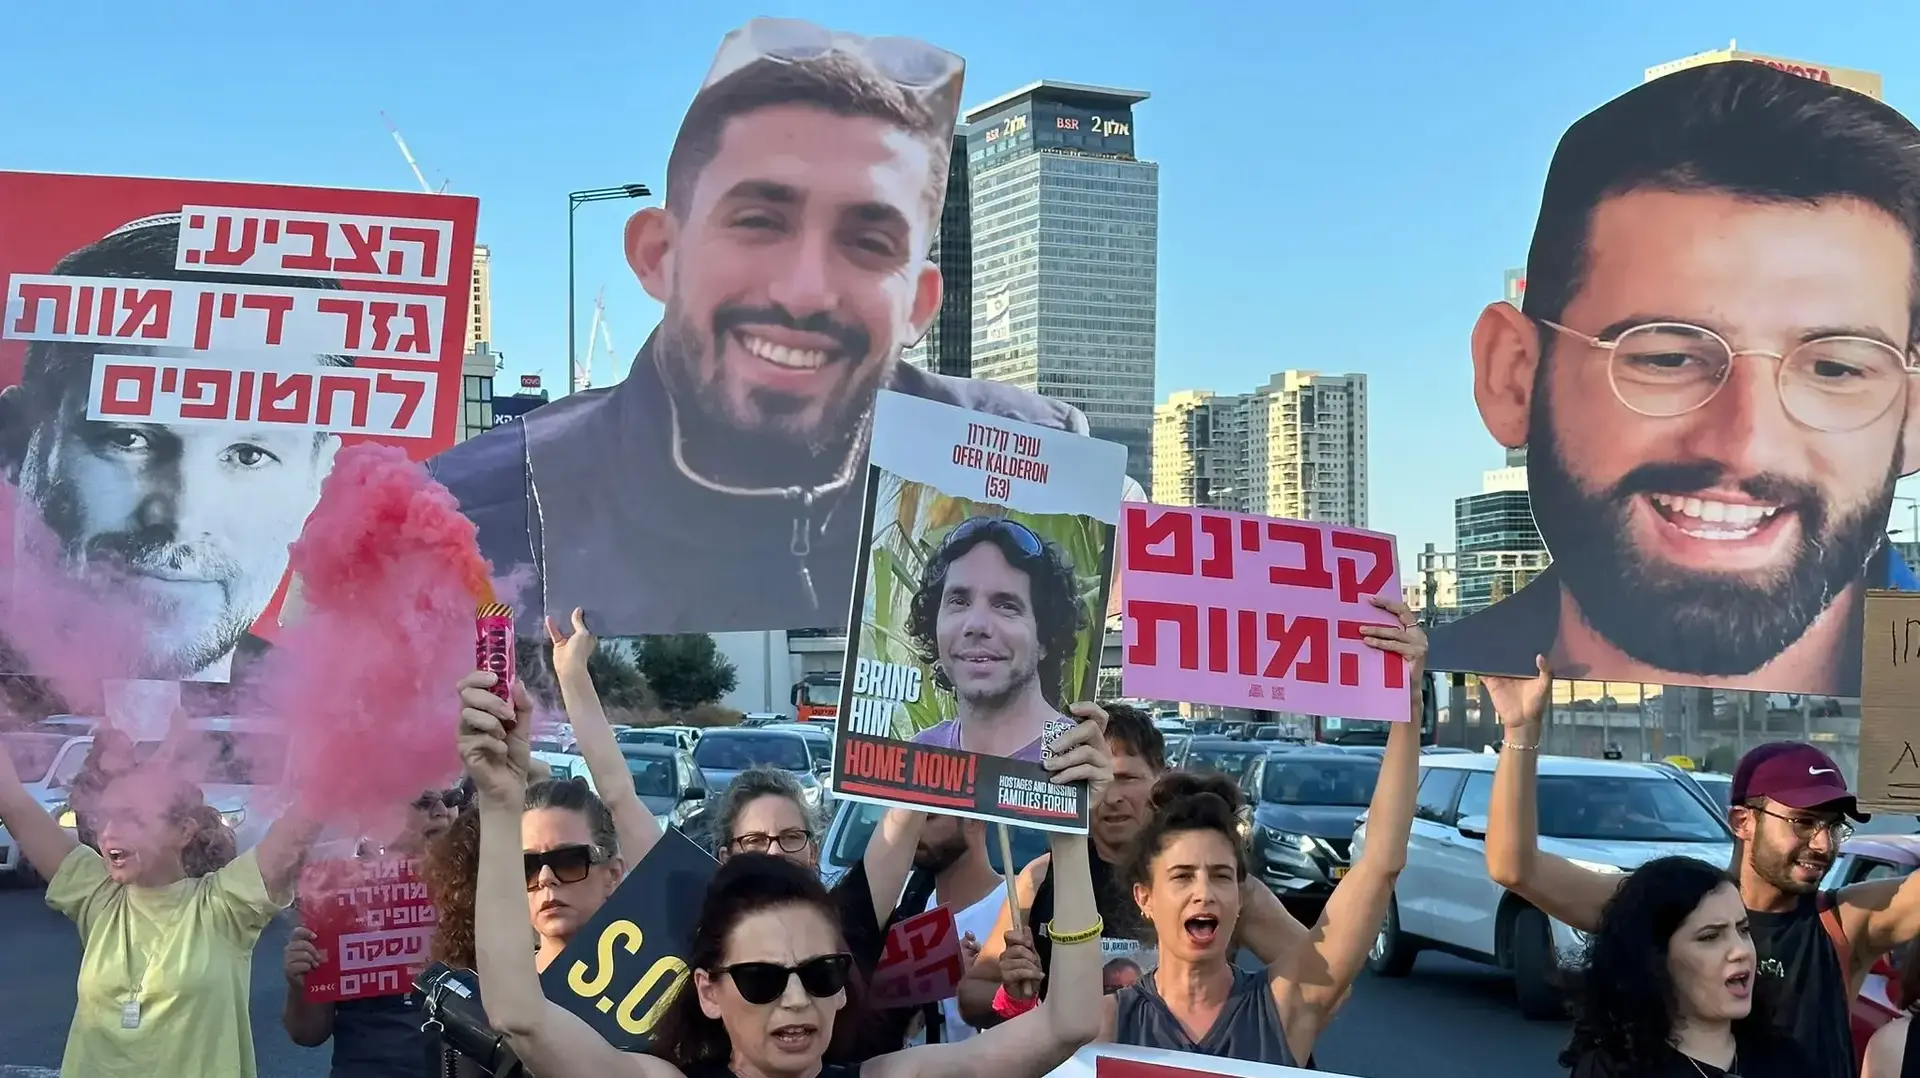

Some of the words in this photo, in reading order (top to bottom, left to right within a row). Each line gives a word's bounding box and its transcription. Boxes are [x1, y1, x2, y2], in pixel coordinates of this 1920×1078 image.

[1003, 117, 1010, 136] 2
[1091, 116, 1102, 132] 2
[1104, 120, 1129, 138] אלון
[185, 214, 440, 278] הצביע:
[13, 283, 173, 340] מוות
[194, 291, 294, 351] דין
[317, 297, 431, 354] גזר
[99, 364, 426, 430] לחטופים
[967, 423, 1009, 452] קלדרון
[1013, 433, 1041, 458] עופר
[952, 444, 983, 470] OFER
[985, 452, 1049, 484] KALDERON
[985, 475, 1010, 501] (53)
[1126, 508, 1394, 604] קבינט
[1127, 600, 1404, 689] המוות
[853, 657, 921, 703] BRING
[848, 696, 893, 738] HIM
[844, 739, 907, 783] HOME
[912, 750, 977, 794] NOW!
[999, 775, 1033, 791] HOSTAGES
[1033, 780, 1047, 793] AND
[1047, 783, 1077, 798] MISSING
[998, 787, 1041, 811] FAMILIES
[1042, 794, 1077, 815] FORUM
[346, 936, 422, 962] עסקה
[340, 970, 398, 996] חיים
